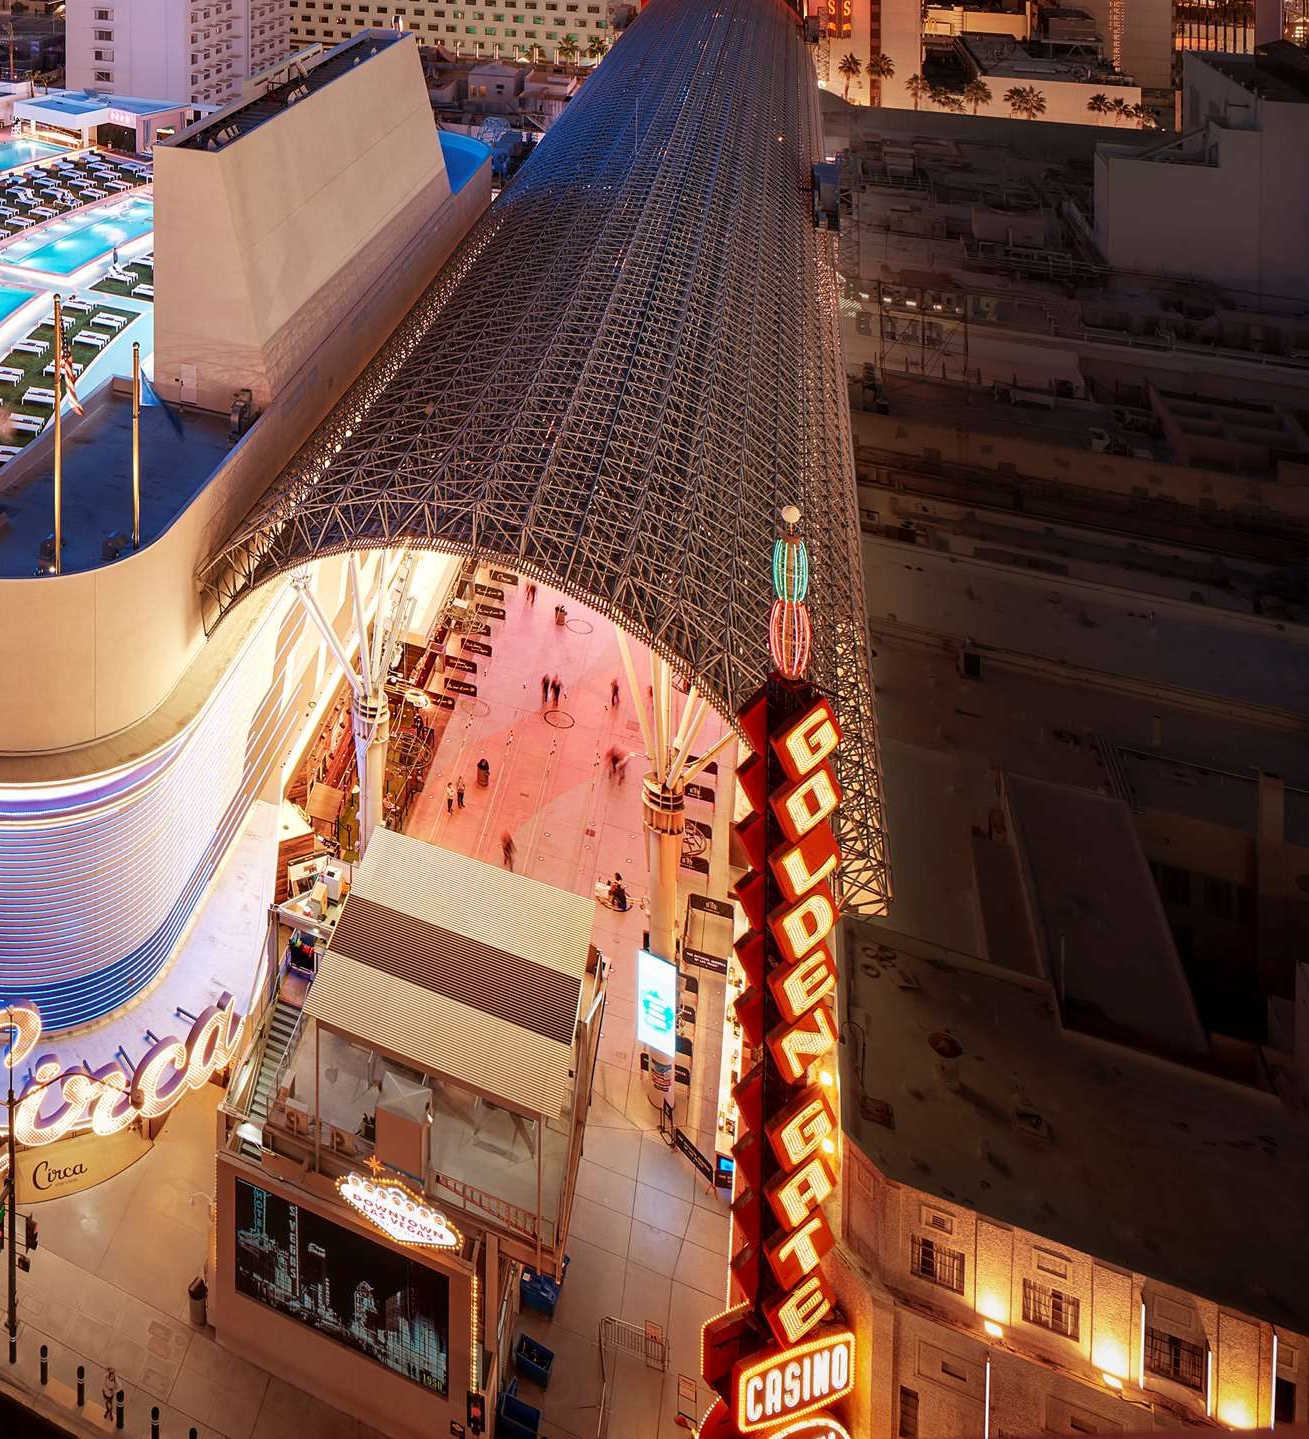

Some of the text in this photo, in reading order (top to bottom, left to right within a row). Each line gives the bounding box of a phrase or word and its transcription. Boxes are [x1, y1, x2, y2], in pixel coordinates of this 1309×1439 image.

[778, 707, 839, 1343] GOLDEN GATE
[32, 1160, 88, 1191] Circa
[352, 1193, 444, 1240] DOWNTOWN
[363, 1205, 433, 1241] LAS VEGAS
[746, 1343, 849, 1422] CASINO
